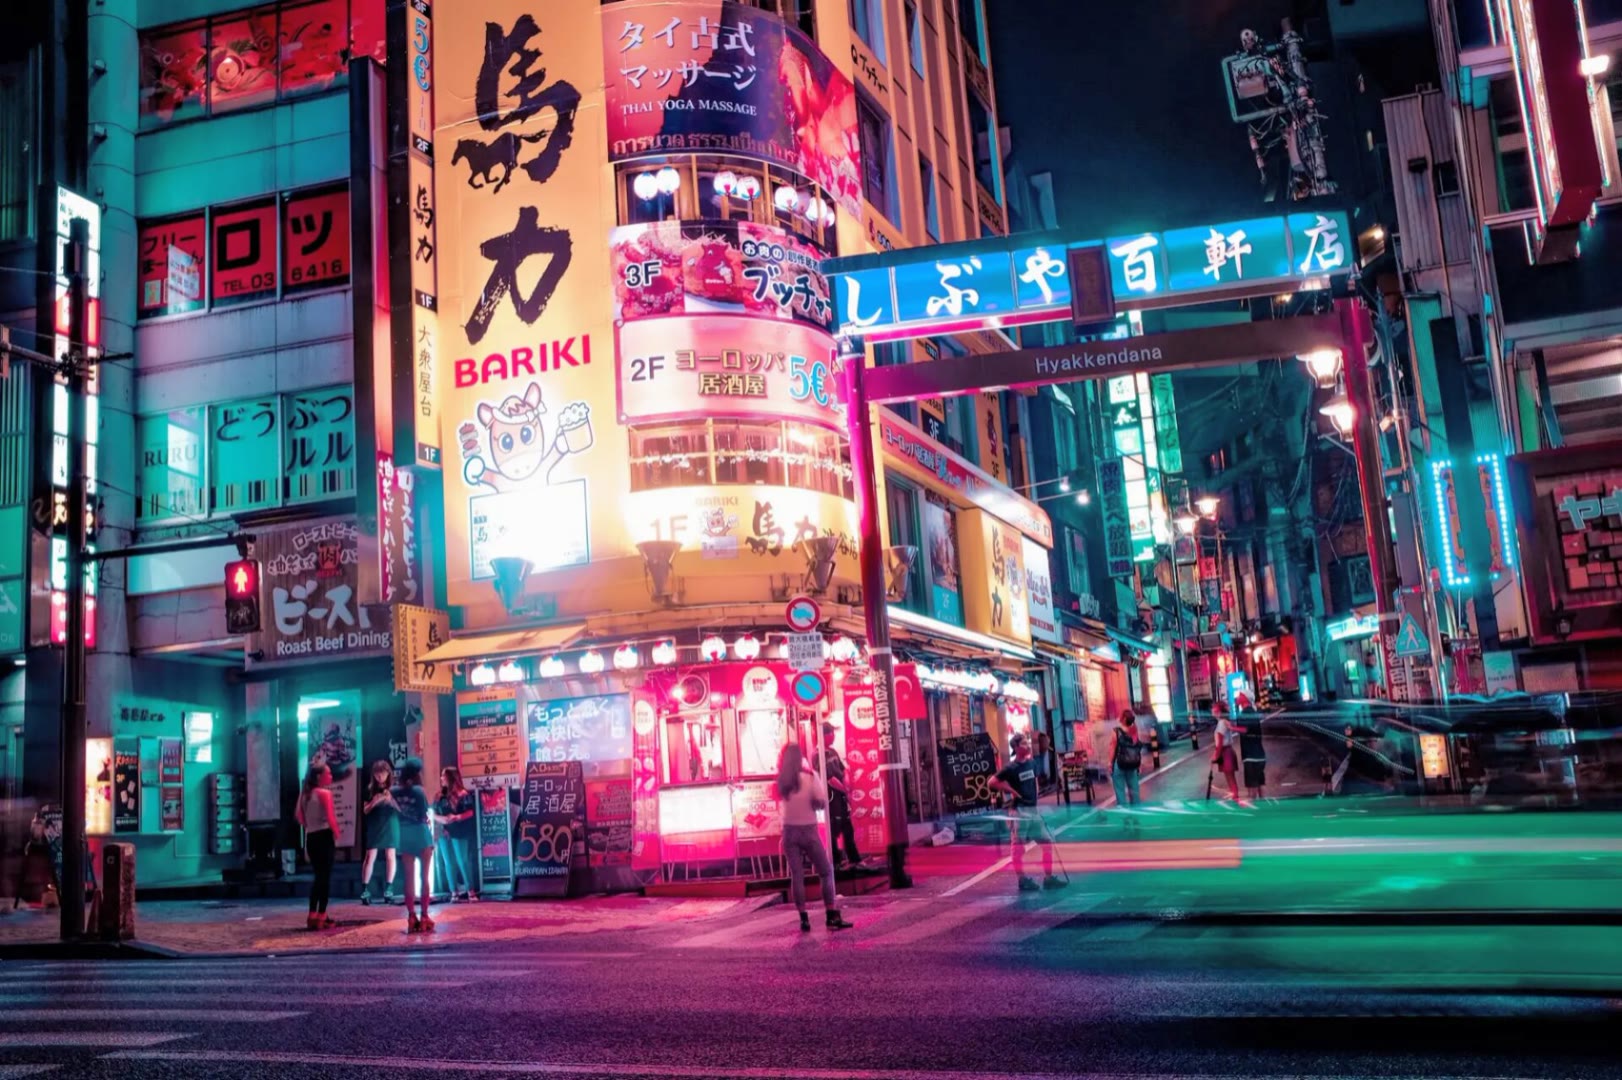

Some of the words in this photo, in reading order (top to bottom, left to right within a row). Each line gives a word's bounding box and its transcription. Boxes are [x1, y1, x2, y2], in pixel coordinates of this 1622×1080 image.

[618, 16, 756, 57] タイ古式
[620, 59, 756, 91] マッサージ
[620, 101, 653, 116] THAI
[657, 99, 694, 112] YOGA
[698, 99, 758, 117] MASSAGE
[416, 138, 429, 152] 2F
[452, 14, 581, 345] 馬力
[413, 184, 433, 263] 馬力
[251, 272, 275, 289] 03
[625, 261, 662, 288] 3F
[843, 246, 1066, 327] しぶや
[1110, 215, 1345, 293] 百軒店
[420, 293, 432, 307] 1F
[454, 334, 591, 389] BARIKI
[630, 355, 666, 382] 2F
[1035, 346, 1163, 375] Hyakkendana
[675, 350, 786, 371] ヨーロッパ
[788, 355, 829, 405] 5€
[699, 372, 767, 397] 居酒屋
[424, 447, 436, 461] 1F
[650, 515, 688, 541] 1F
[273, 580, 371, 635] ビースト
[277, 637, 312, 656] Roast
[315, 634, 344, 652] Beef
[347, 631, 391, 648] Dining
[952, 760, 991, 777] FOOD
[529, 778, 577, 793] ヨーロッパ
[964, 774, 993, 802] 58
[525, 793, 577, 815] 居酒屋
